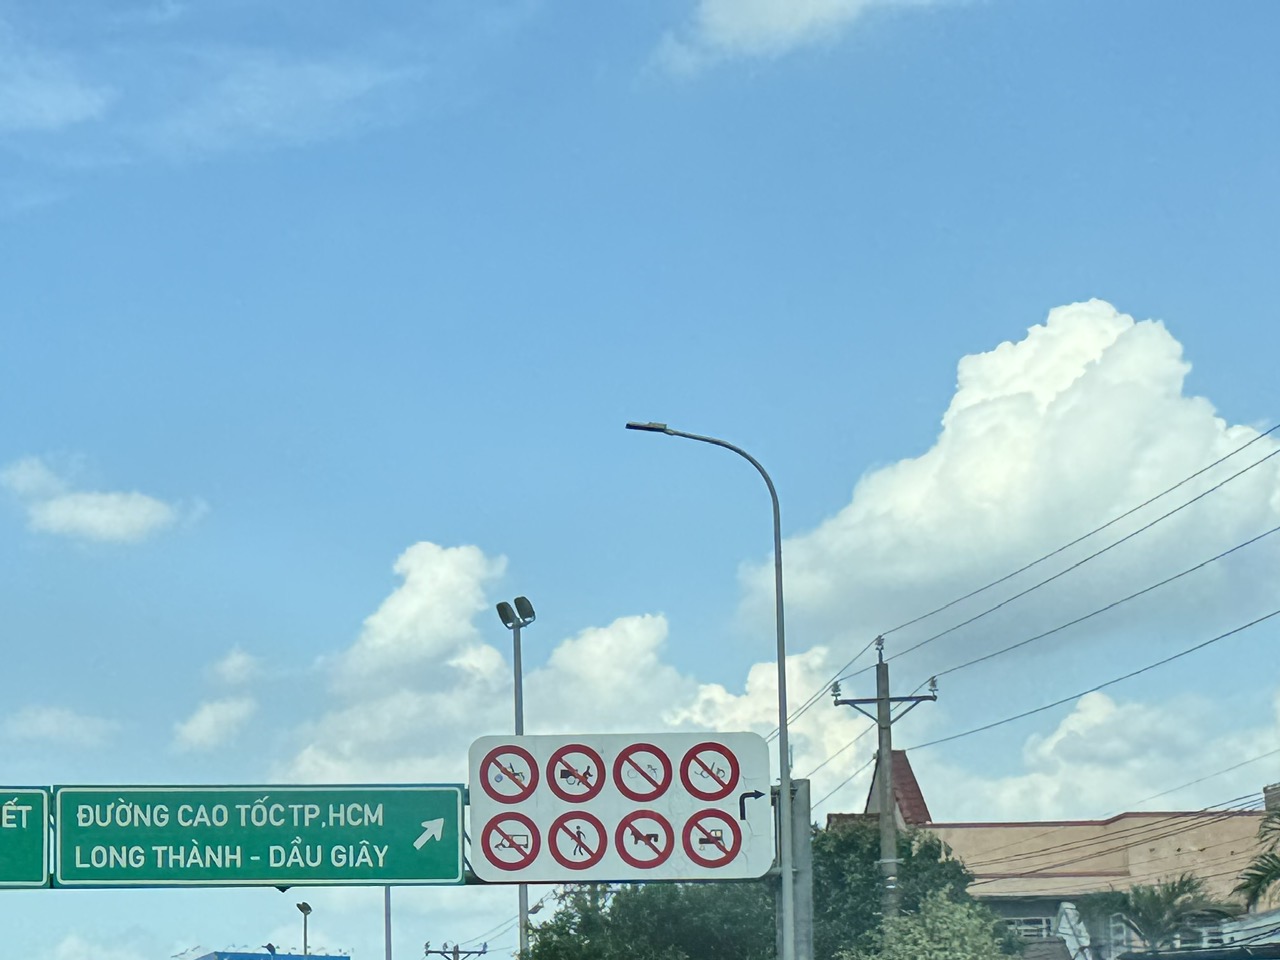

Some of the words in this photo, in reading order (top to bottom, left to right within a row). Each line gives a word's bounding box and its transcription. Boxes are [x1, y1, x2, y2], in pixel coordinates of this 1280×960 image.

[77, 798, 169, 827] ĐƯỜNG
[177, 804, 229, 827] CAO
[235, 795, 285, 827] TỐC
[75, 845, 145, 868] LONG
[151, 839, 242, 868] THÀNH
[331, 840, 388, 868] GIÂY
